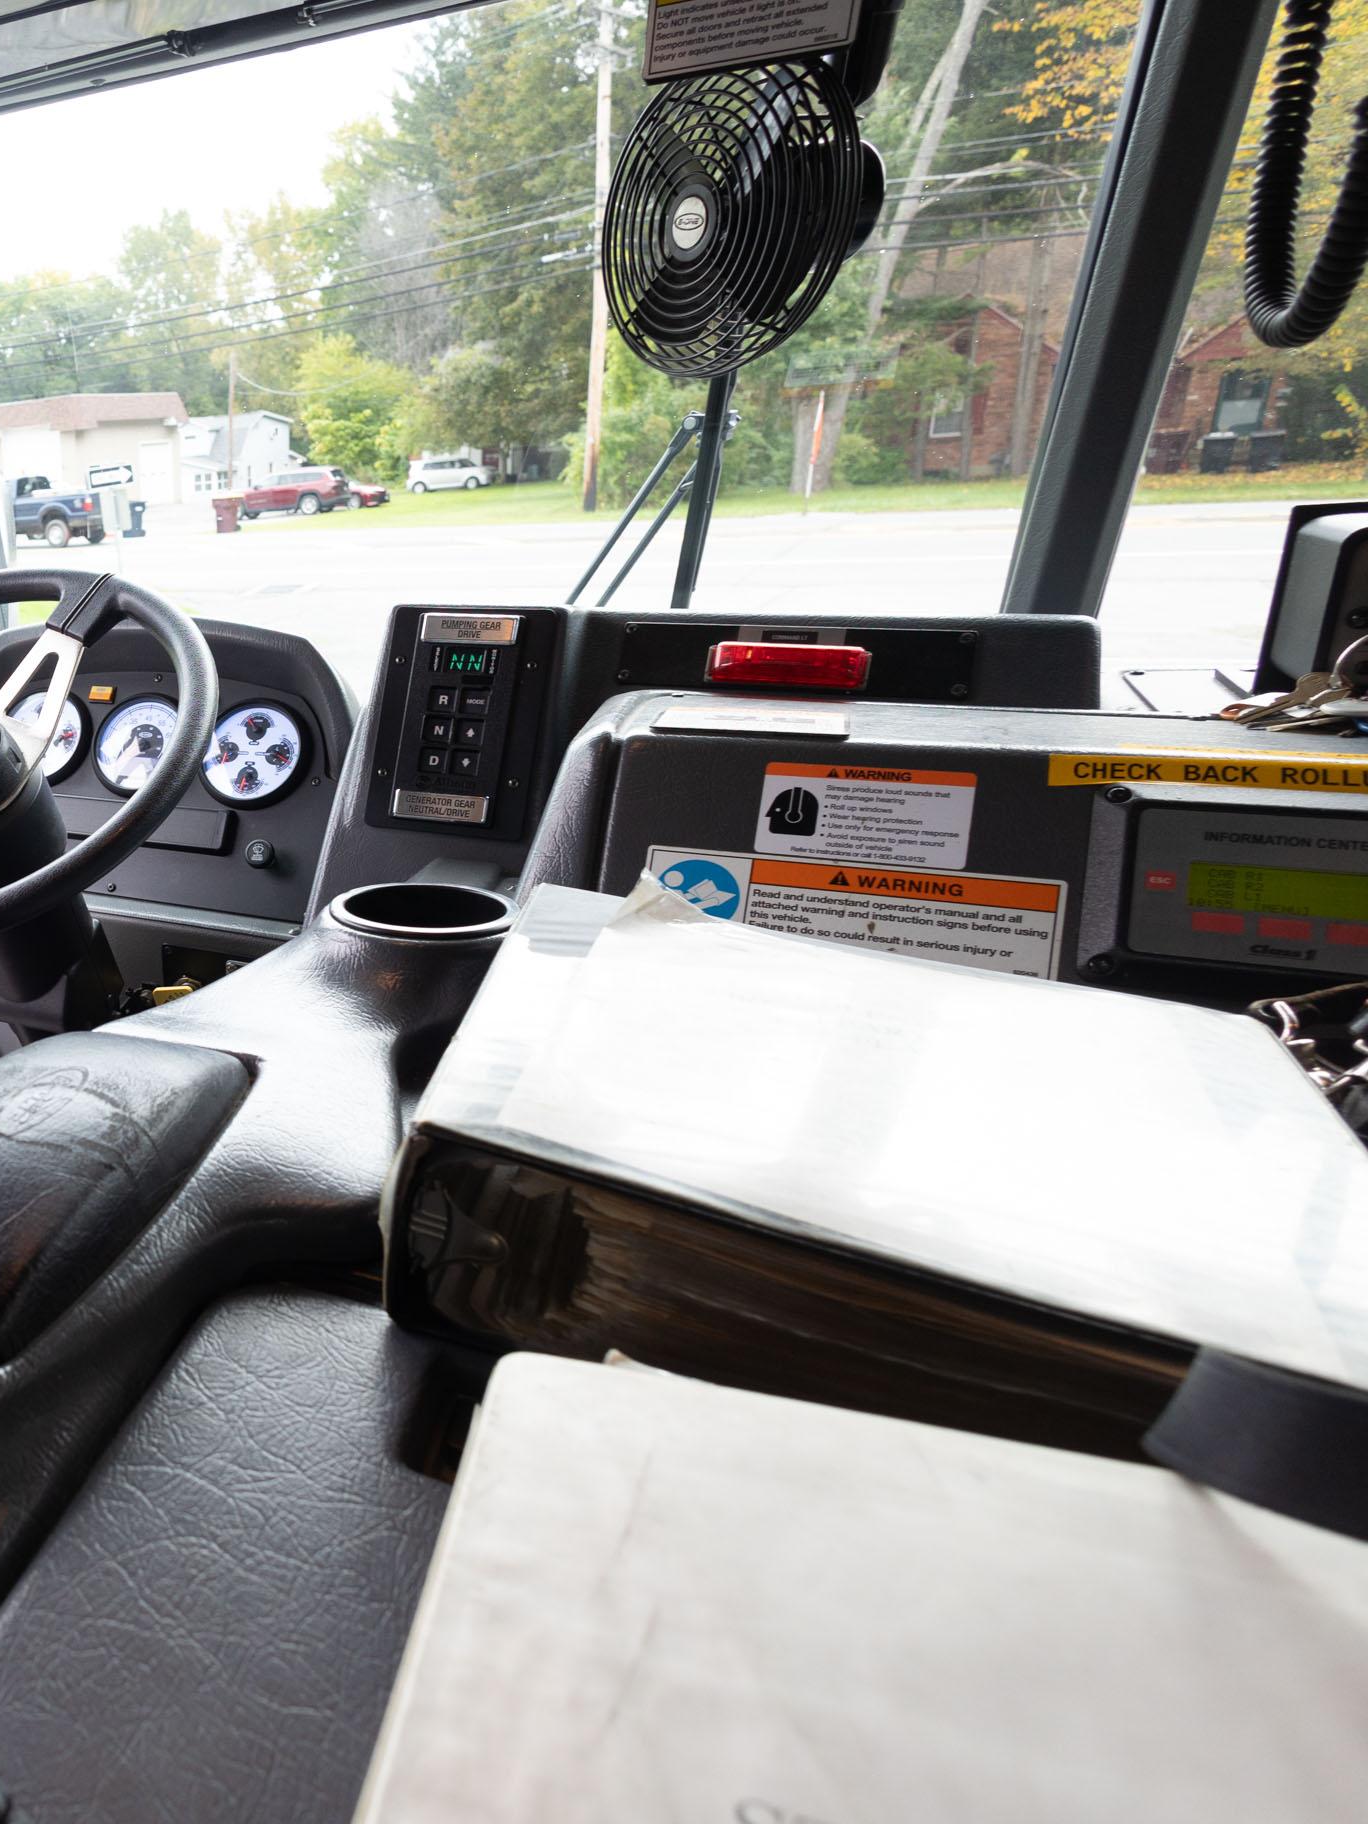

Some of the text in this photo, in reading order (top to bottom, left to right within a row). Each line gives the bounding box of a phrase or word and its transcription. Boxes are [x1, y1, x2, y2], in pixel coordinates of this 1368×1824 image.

[655, 30, 685, 41] Secure
[698, 23, 722, 33] doors
[724, 18, 742, 28] and
[786, 2, 828, 17] extended
[656, 22, 668, 30] Do
[670, 17, 689, 27] NOT
[654, 36, 706, 52] components
[708, 31, 735, 42] before
[736, 25, 769, 36] moving
[688, 41, 733, 57] equipment
[734, 36, 770, 48] damage
[772, 30, 797, 41] could
[441, 619, 502, 631] PUMPING GEAR
[457, 629, 482, 639] DRIVE
[438, 694, 449, 706] R
[433, 725, 444, 736] N
[428, 755, 440, 767] D
[845, 769, 912, 782] WARNING
[1073, 761, 1163, 781] CHECK
[1183, 764, 1259, 784] BACK
[824, 793, 906, 806] may damage hearing
[851, 787, 884, 797] produce
[885, 788, 903, 796] loud
[903, 790, 933, 798] sounds
[934, 791, 952, 799] that
[406, 795, 476, 809] GENERATOR GEAR
[829, 803, 846, 811] Roll
[858, 806, 893, 814] windows
[408, 804, 471, 818] NEUTRAL/DRIVE
[829, 812, 923, 827] Wear hearing protection
[827, 822, 960, 839] Use only for emergency response
[824, 840, 893, 852] outside of vehicle
[826, 833, 849, 841] Avoid
[850, 835, 886, 845] exposure
[919, 840, 946, 848] sound
[1203, 830, 1312, 849] INFORMATION
[816, 848, 852, 858] instructions
[857, 874, 964, 897] WARNING
[1148, 875, 1173, 886] ESC
[752, 888, 1023, 924] Read and understand operator's manual and all
[749, 909, 812, 924] this vehicle.
[751, 899, 1049, 940] attached warning and instruction signs before using
[786, 924, 797, 934] to
[800, 926, 815, 936] do
[817, 929, 831, 938] so
[833, 930, 865, 942] could
[867, 934, 901, 945] result
[903, 937, 914, 947] in
[916, 940, 961, 952] serious
[963, 943, 998, 958] injury
[999, 948, 1015, 958] or
